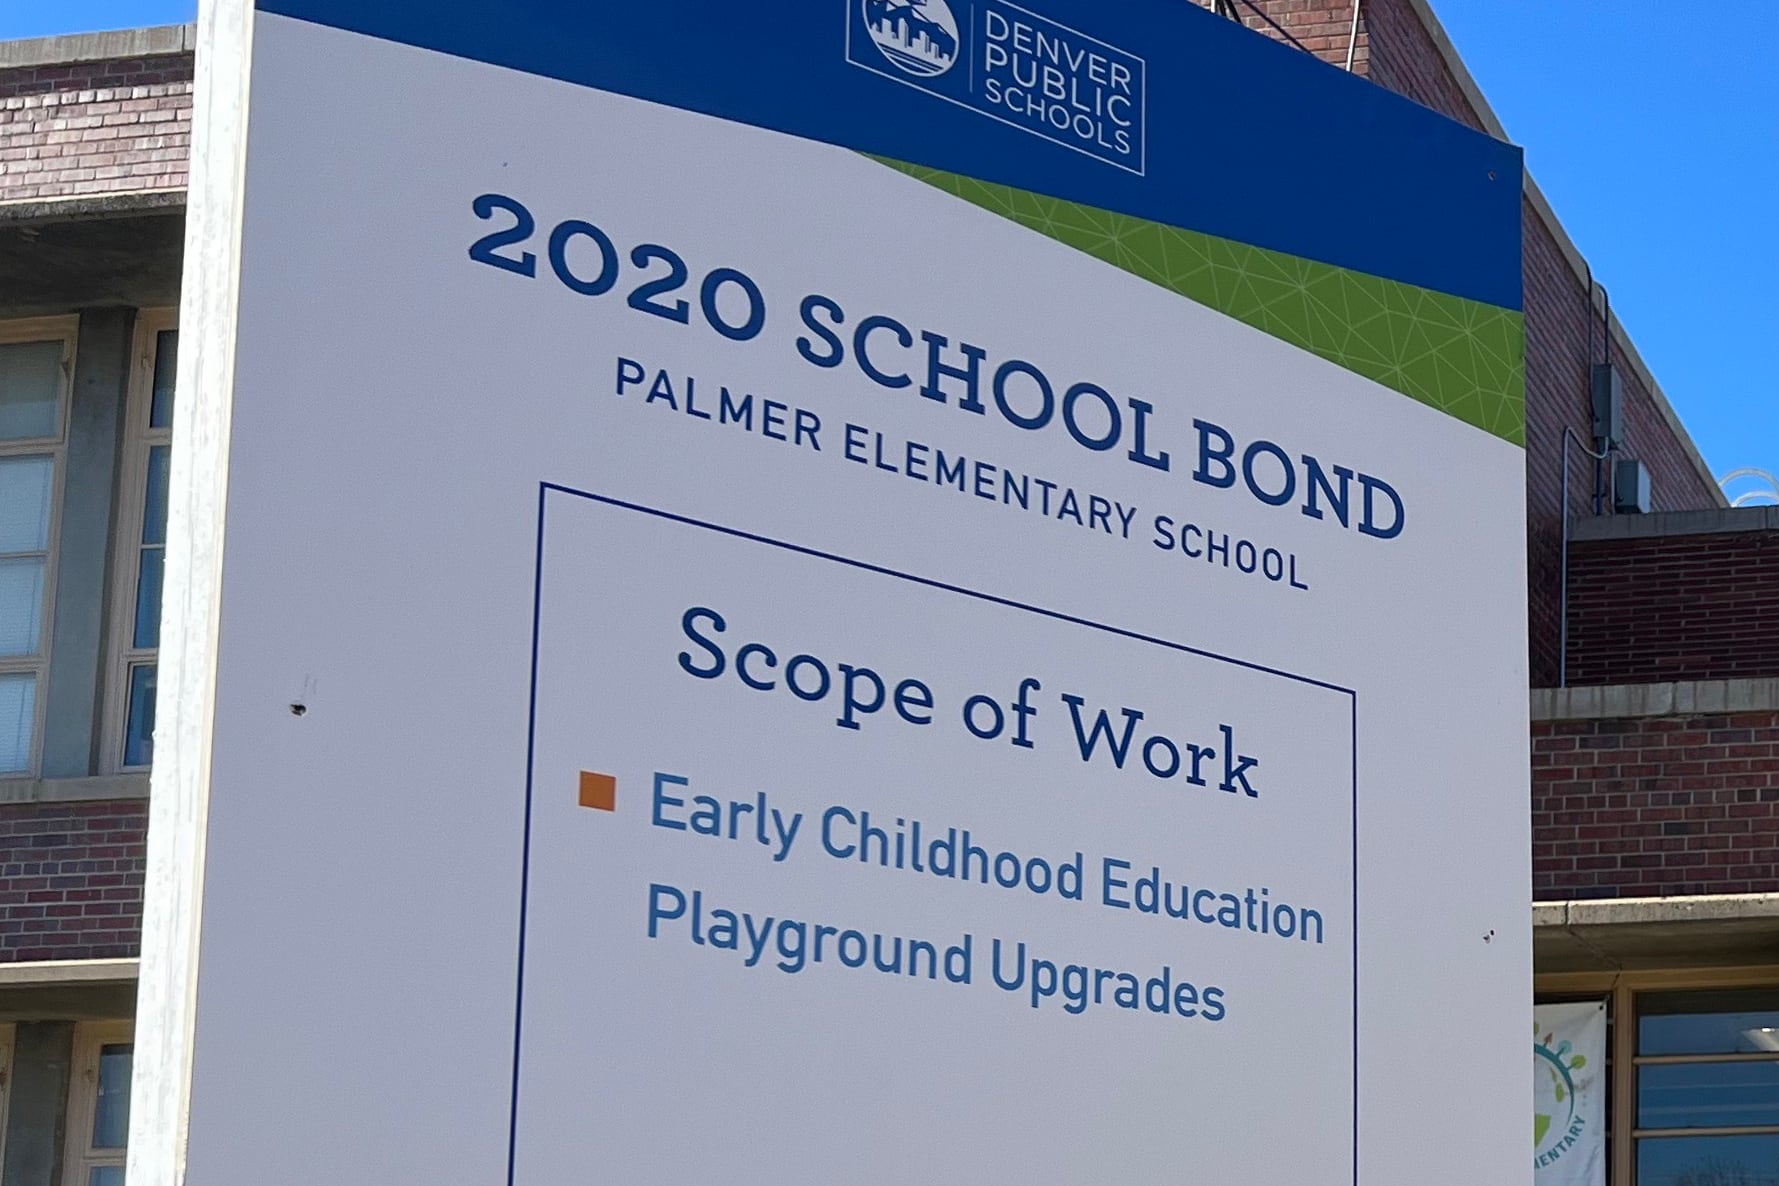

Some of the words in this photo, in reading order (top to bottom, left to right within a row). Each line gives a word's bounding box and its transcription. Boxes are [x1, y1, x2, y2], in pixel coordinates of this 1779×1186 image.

[985, 78, 1130, 154] SCHOOLS
[986, 10, 1131, 95] DENVER
[986, 43, 1131, 127] PUBLIC
[468, 193, 765, 341] 2020
[796, 294, 1170, 473] SCHOOL
[1192, 418, 1406, 540] BOND
[616, 357, 822, 452] PALMER
[843, 425, 1137, 541] ELEMENTARY
[1152, 515, 1309, 591] SCHOOL
[677, 607, 934, 729] Scope
[962, 678, 1041, 749] of
[1062, 693, 1259, 798] Work
[652, 772, 802, 861] Early
[821, 805, 1084, 901] Childhood
[1102, 857, 1325, 943] Education
[647, 883, 972, 985] Playground
[992, 938, 1226, 1022] Upgrades
[1534, 1115, 1585, 1169] ENTARY
